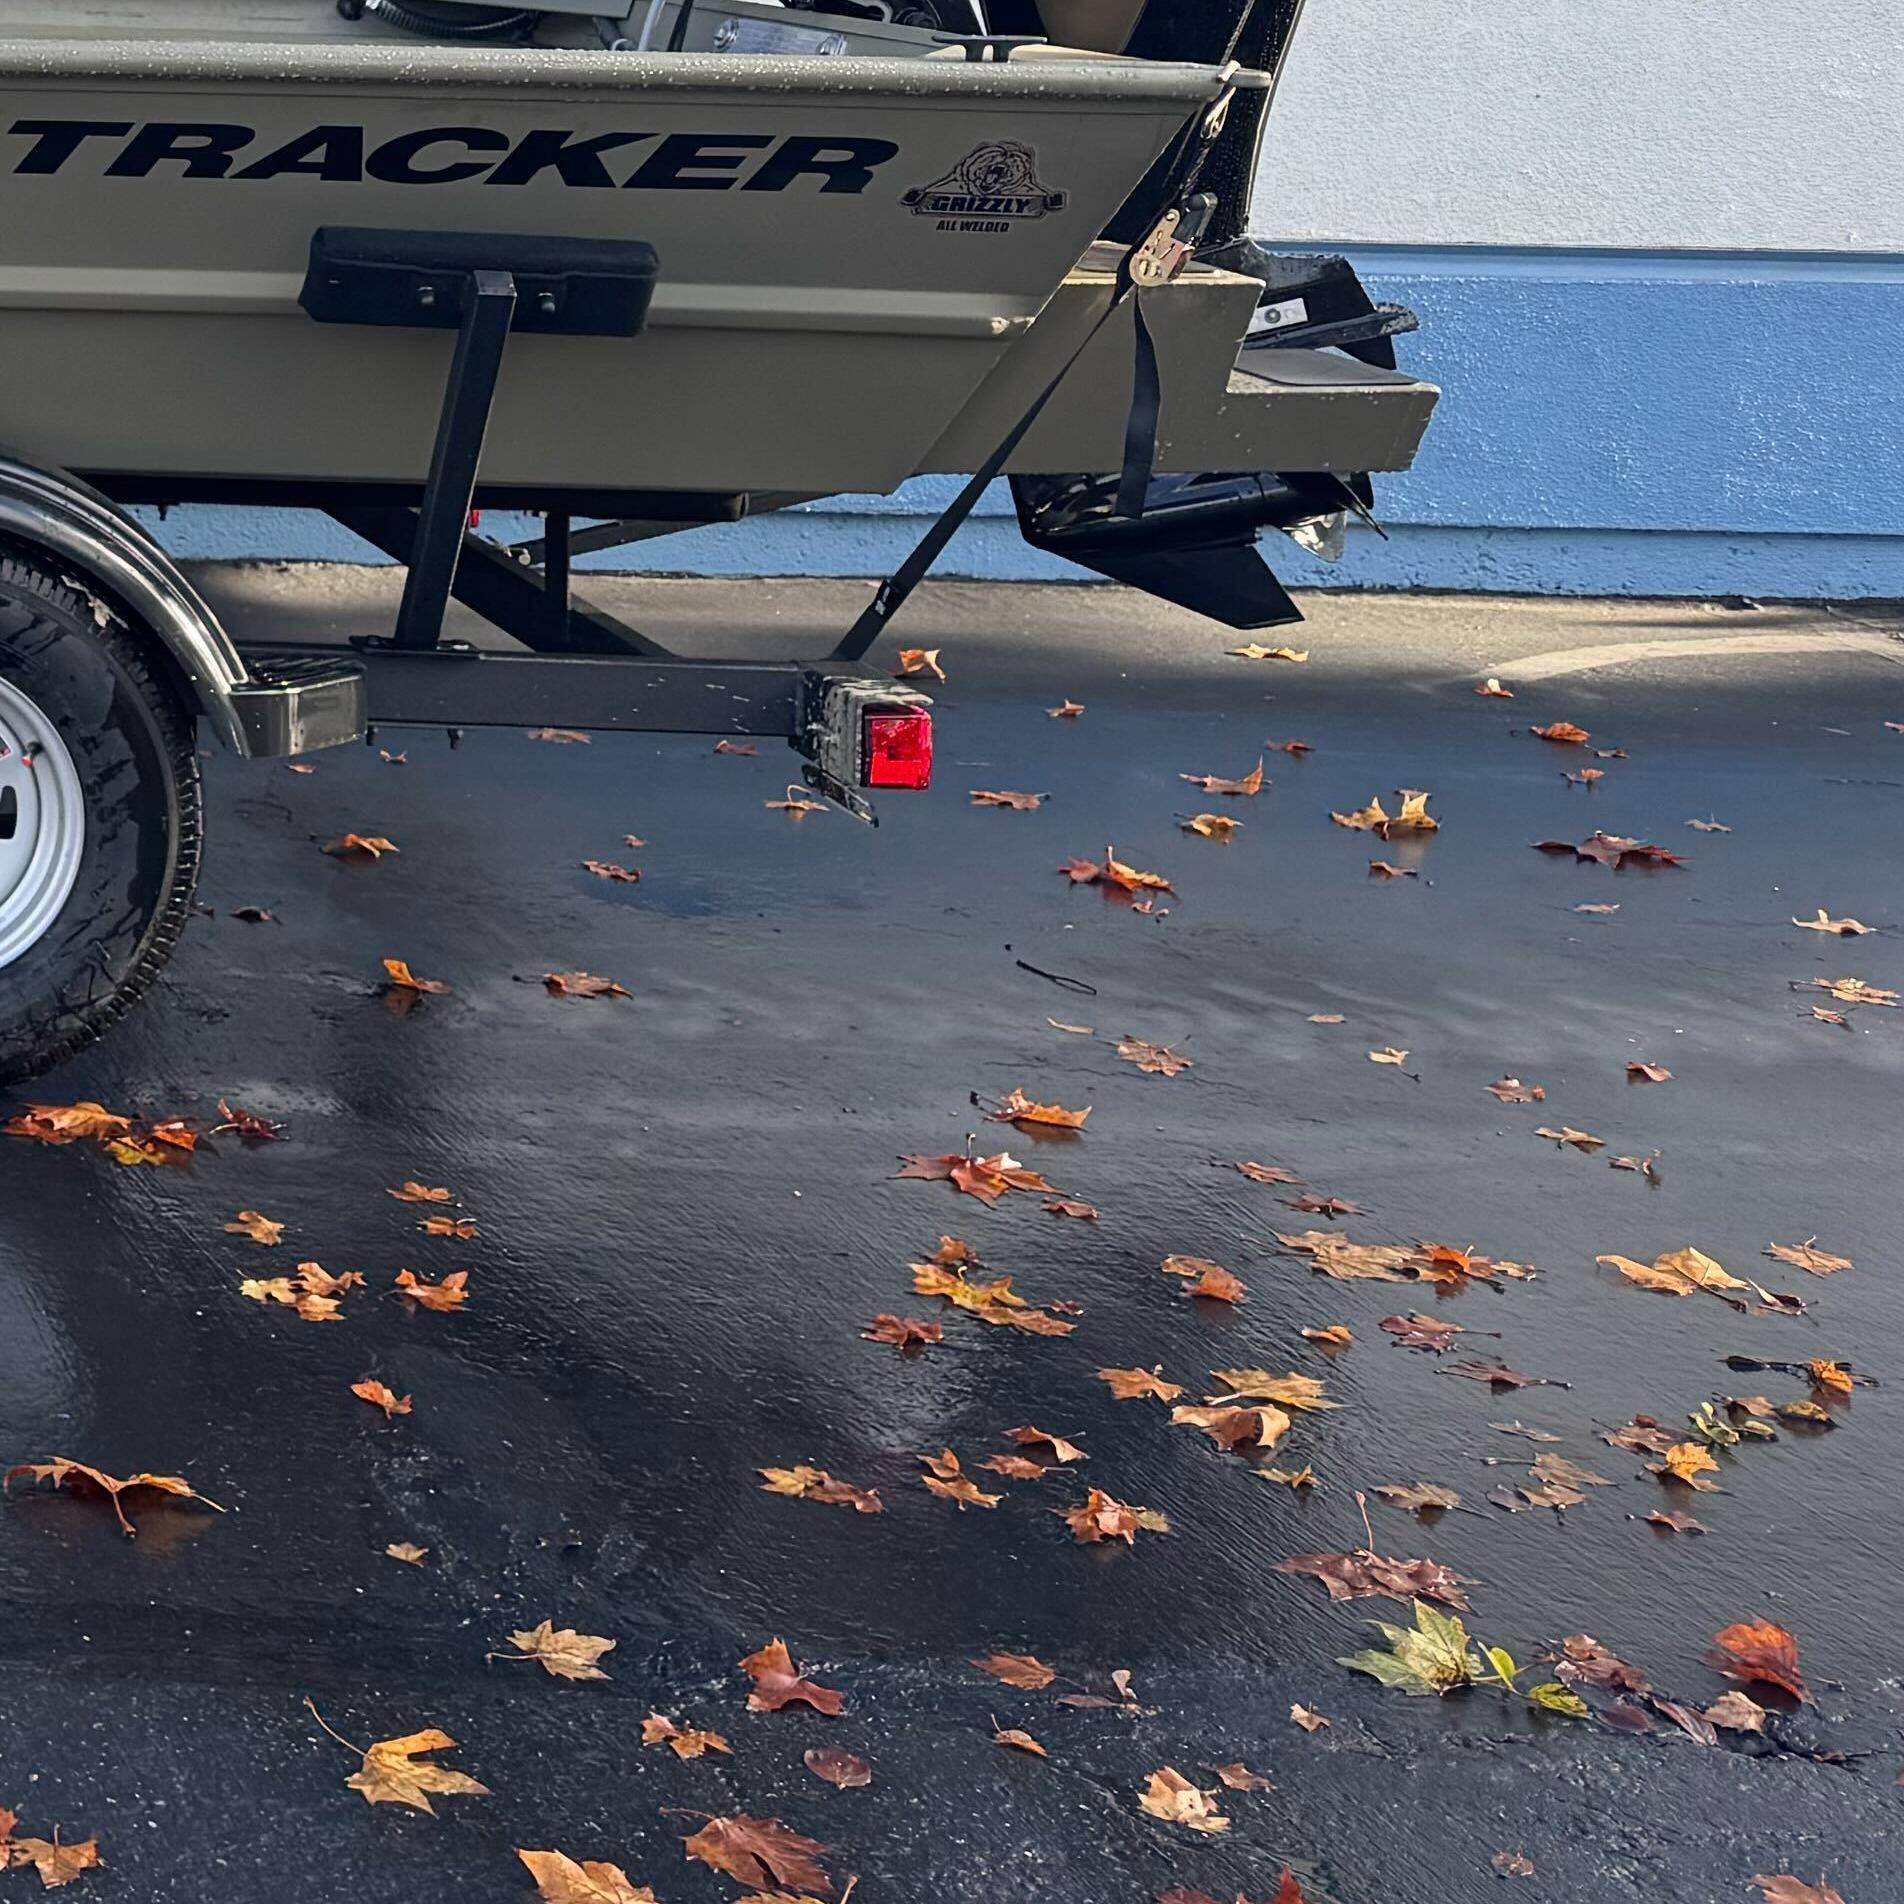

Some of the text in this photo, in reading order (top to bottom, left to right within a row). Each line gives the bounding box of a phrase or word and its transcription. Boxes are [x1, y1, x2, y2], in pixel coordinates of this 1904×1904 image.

[6, 119, 900, 195] TRACKER
[930, 195, 1031, 214] GRIZZLY
[935, 219, 957, 232] ALL
